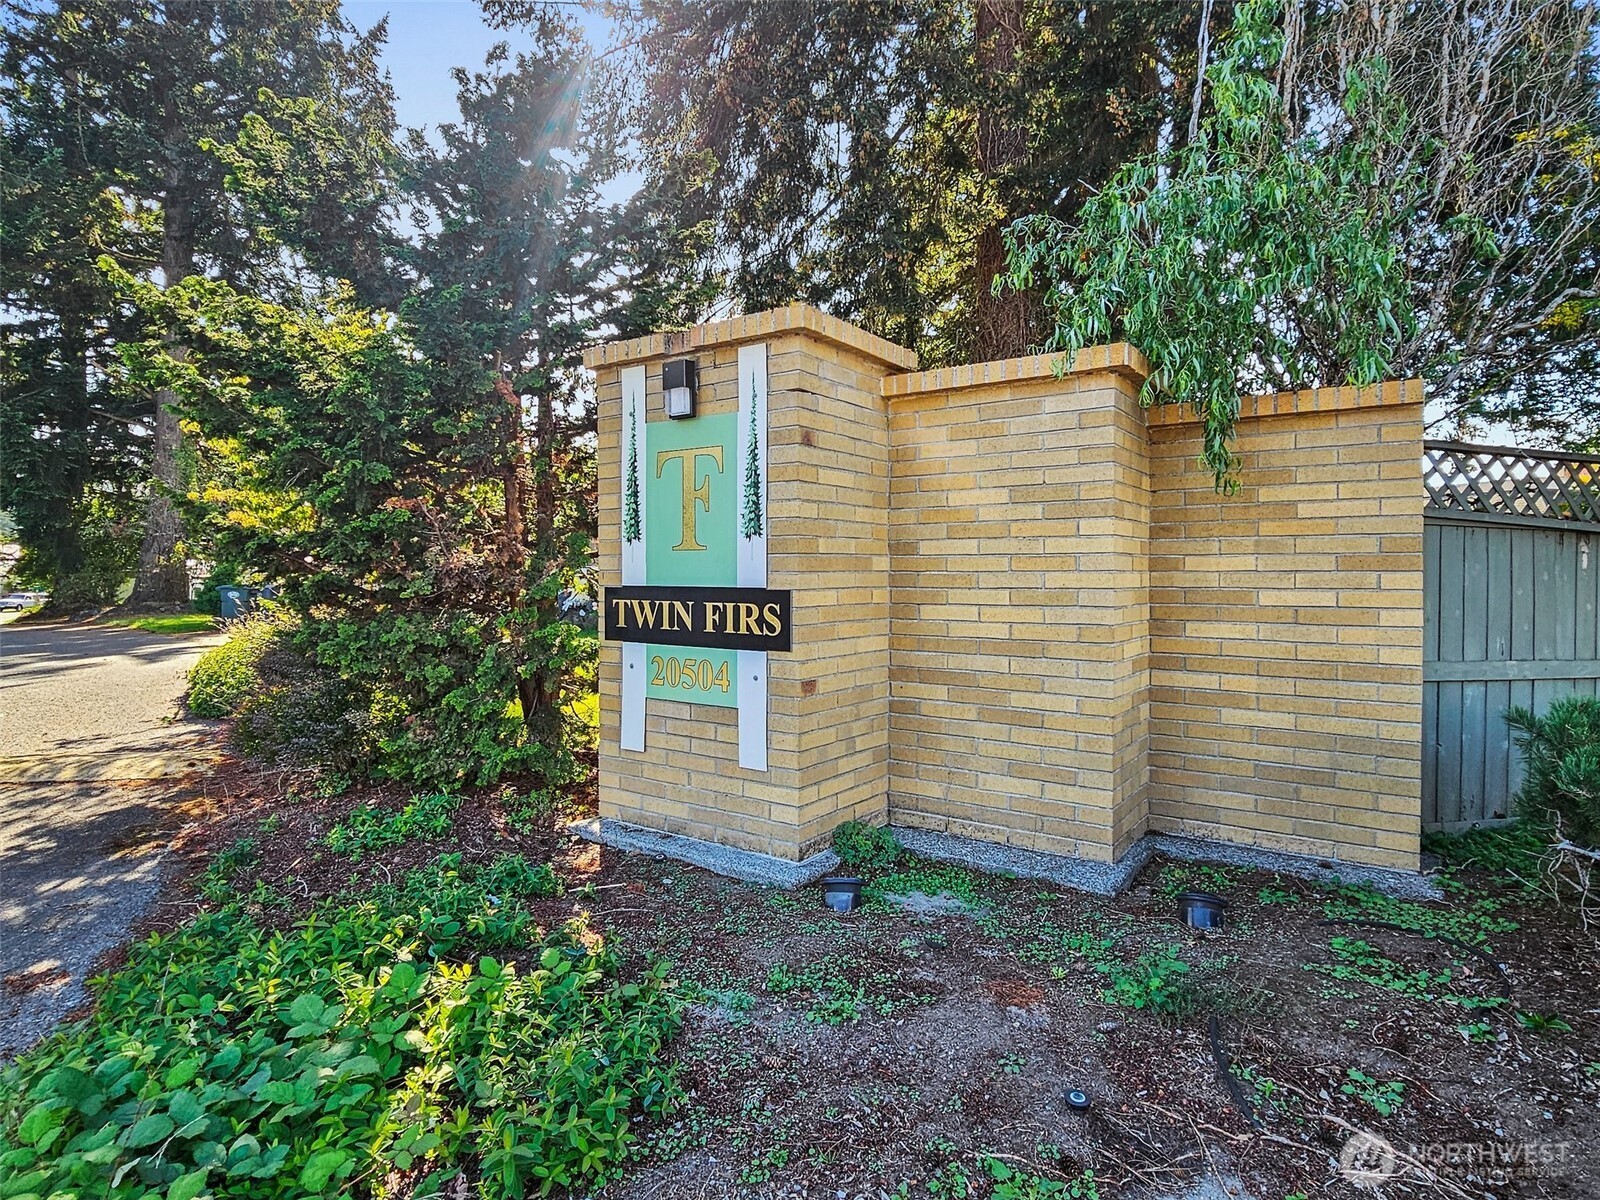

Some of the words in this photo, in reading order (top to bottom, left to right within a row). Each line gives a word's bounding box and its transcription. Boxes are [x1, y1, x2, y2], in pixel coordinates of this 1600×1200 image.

[612, 599, 694, 632] TWIN
[703, 602, 782, 637] FIRS
[651, 655, 730, 693] 20504
